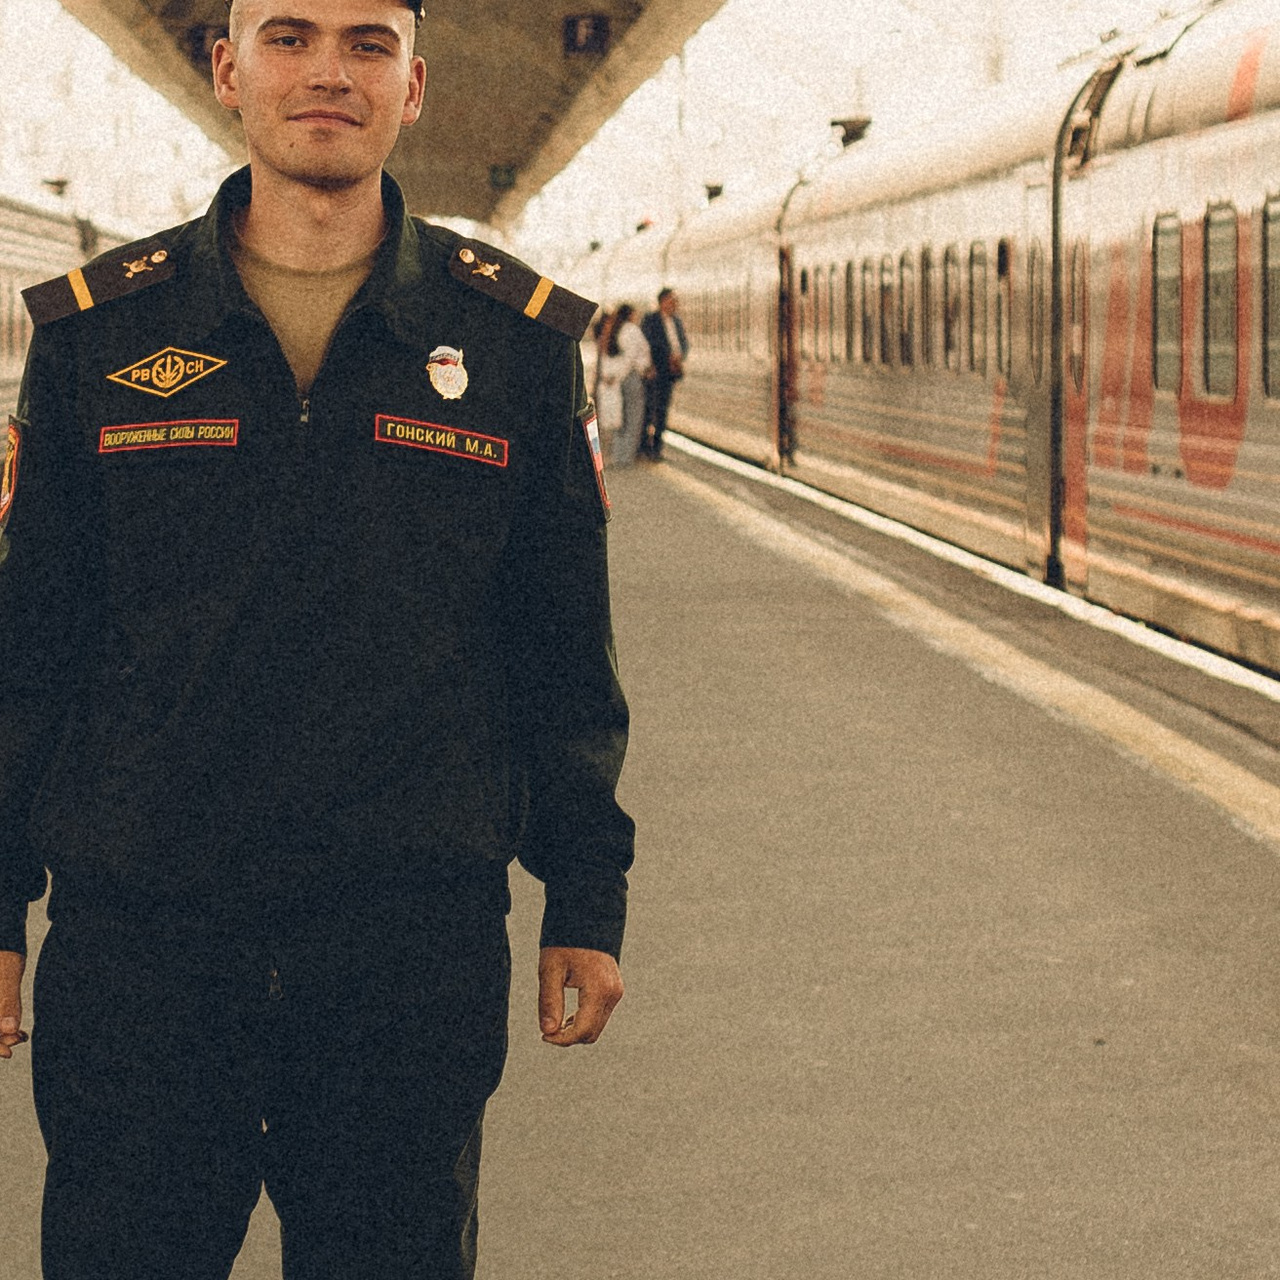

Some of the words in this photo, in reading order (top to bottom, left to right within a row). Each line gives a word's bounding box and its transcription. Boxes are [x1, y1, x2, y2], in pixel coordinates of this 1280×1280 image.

[197, 425, 234, 440] РОССИИ
[386, 422, 456, 449] ГОНСКИЙ
[465, 437, 497, 459] М.А.
